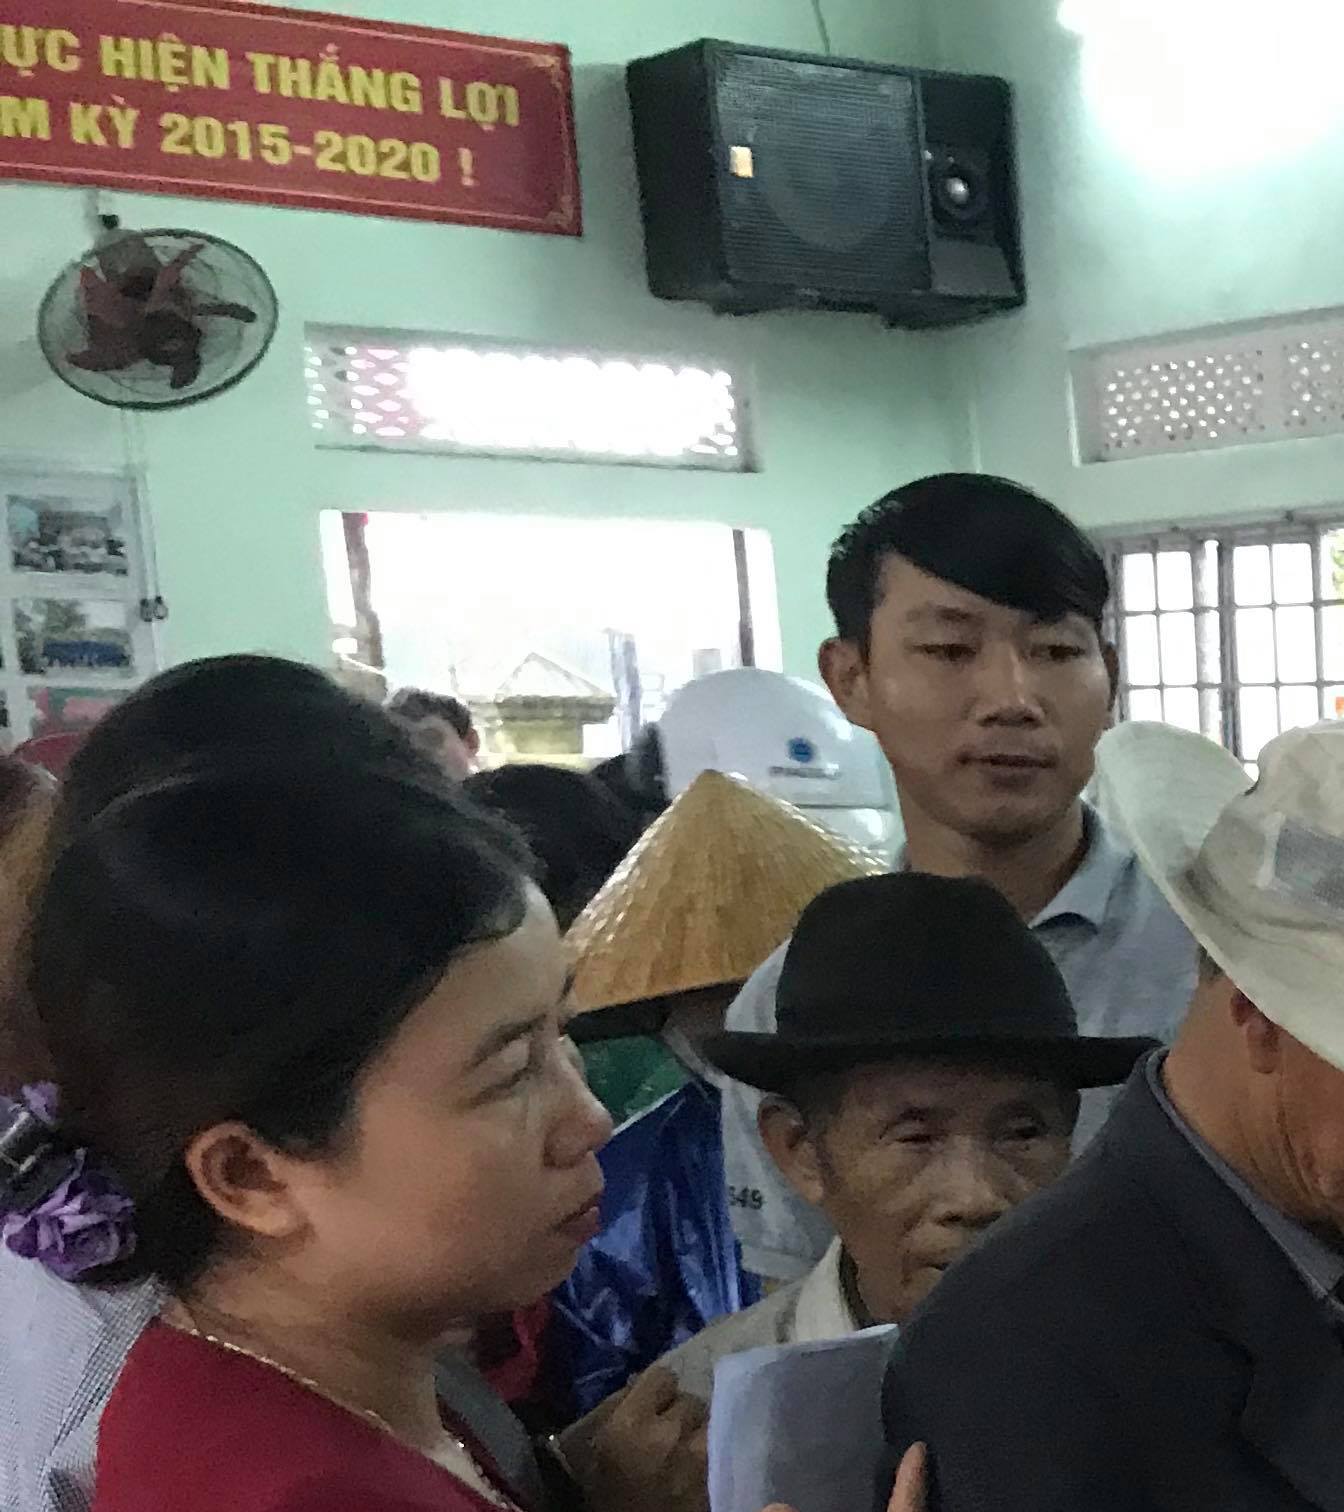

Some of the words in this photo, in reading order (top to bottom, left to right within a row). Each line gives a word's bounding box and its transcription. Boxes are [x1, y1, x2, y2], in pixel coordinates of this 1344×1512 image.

[99, 32, 231, 92] HIỆN
[244, 43, 423, 116] THẮNG
[438, 76, 521, 131] LỢI
[69, 94, 141, 150] KỲ
[158, 112, 442, 184] 2015-2020
